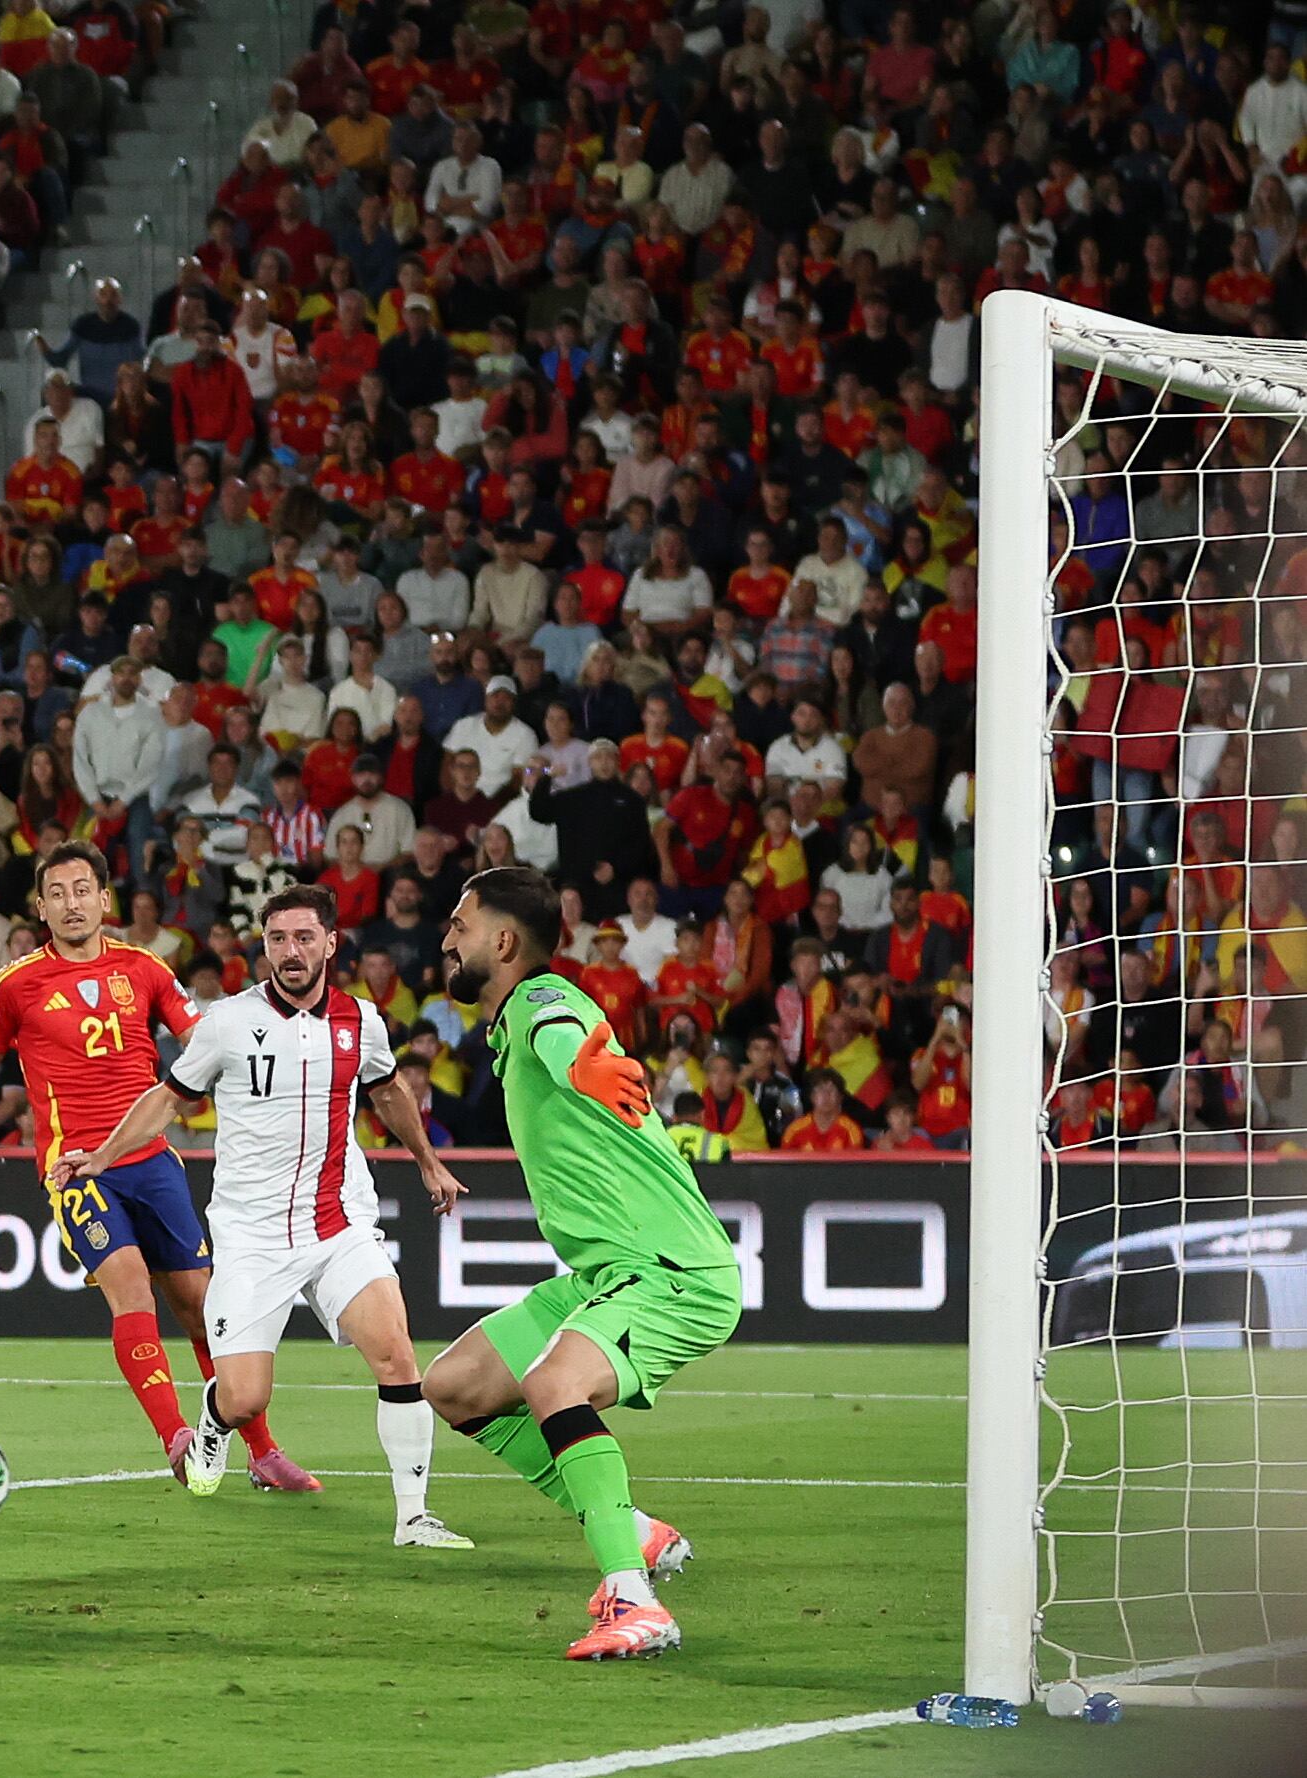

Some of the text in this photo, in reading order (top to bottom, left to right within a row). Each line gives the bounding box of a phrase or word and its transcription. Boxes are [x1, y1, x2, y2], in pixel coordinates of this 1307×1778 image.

[80, 1012, 124, 1058] 21
[246, 1054, 276, 1098] 17
[62, 1178, 109, 1227] 21
